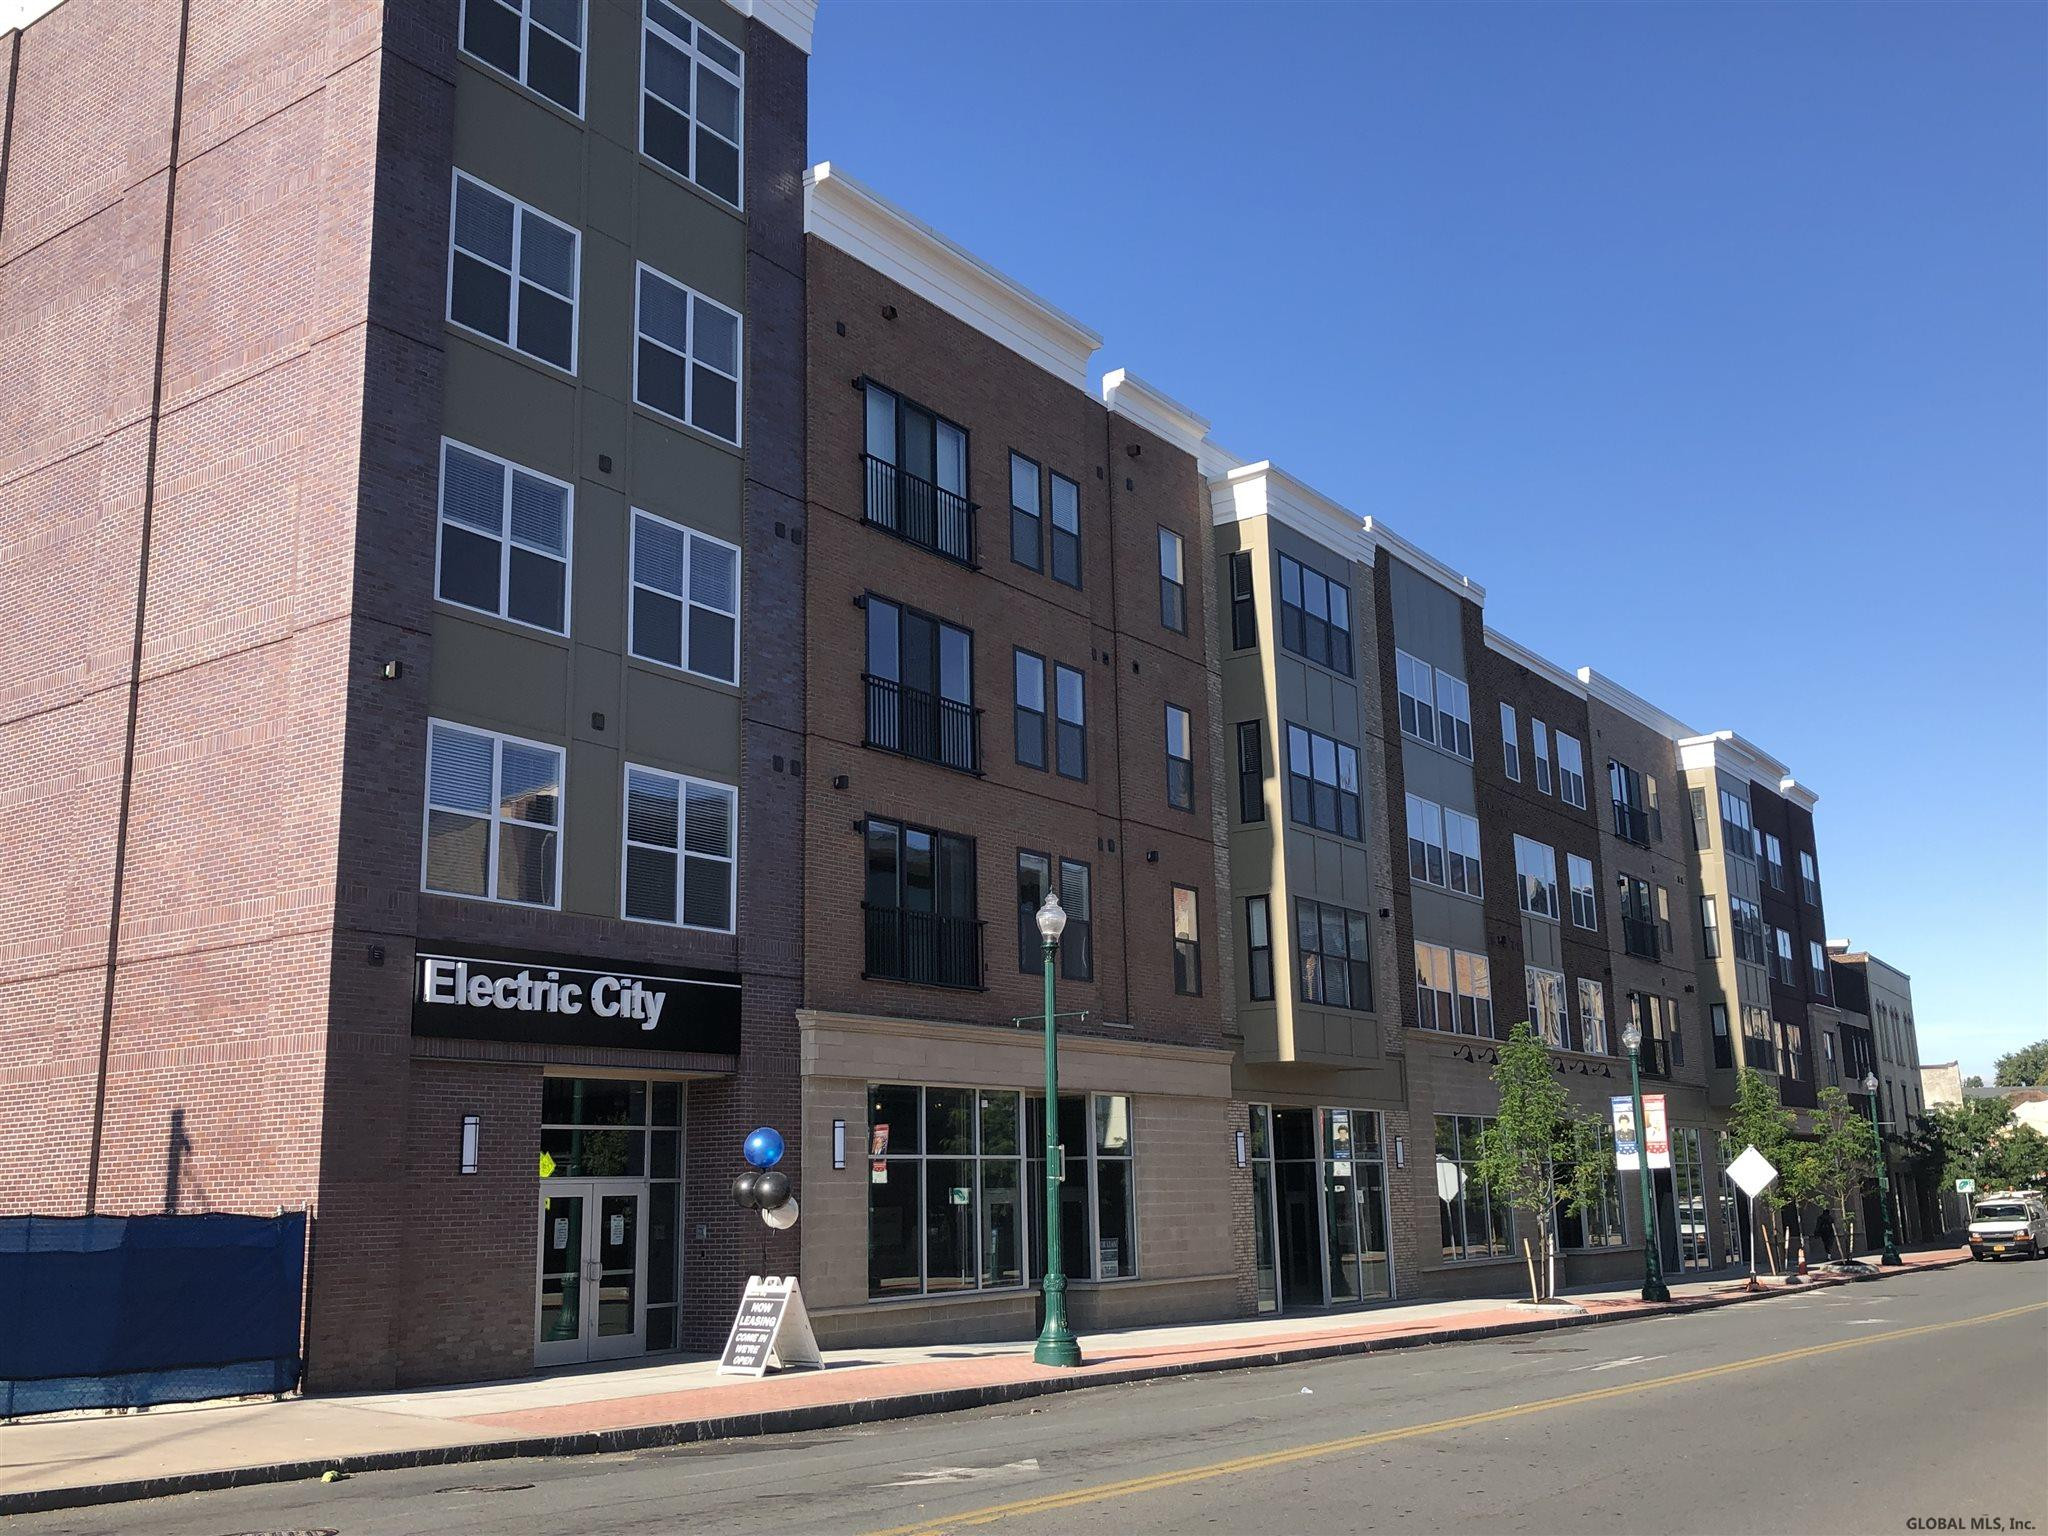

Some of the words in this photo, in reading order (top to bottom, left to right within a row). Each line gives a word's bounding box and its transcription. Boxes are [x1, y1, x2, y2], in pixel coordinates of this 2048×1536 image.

[424, 958, 583, 1014] Electric
[590, 976, 667, 1031] City
[751, 1303, 774, 1313] NOW
[739, 1316, 777, 1327] LEASING
[735, 1333, 758, 1343] COME
[759, 1333, 768, 1343] IN
[733, 1356, 755, 1365] OPEN
